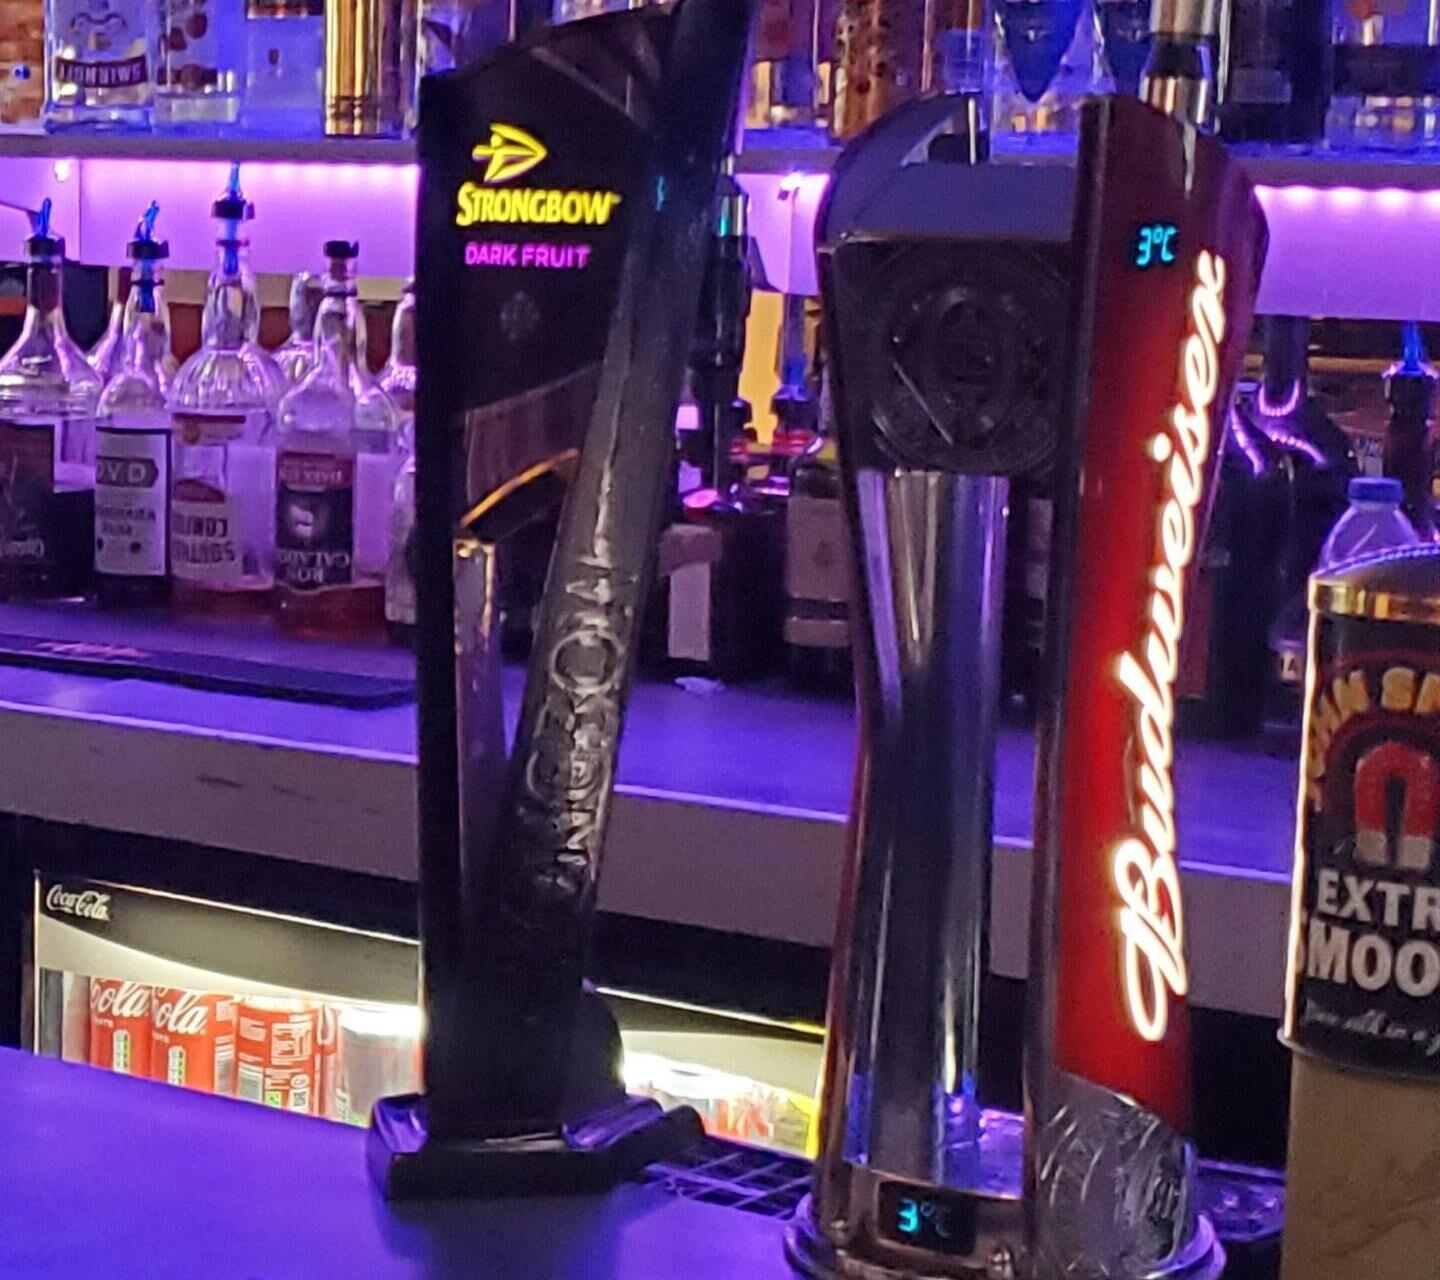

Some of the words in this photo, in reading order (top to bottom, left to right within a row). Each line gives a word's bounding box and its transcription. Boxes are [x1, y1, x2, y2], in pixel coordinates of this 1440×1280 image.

[455, 180, 616, 227] STRONGBOW
[463, 240, 519, 268] DARK
[521, 243, 593, 270] FRUIT
[1108, 249, 1226, 1042] Budweiser
[45, 883, 113, 922] Coca-Cola
[1296, 909, 1440, 998] MOO
